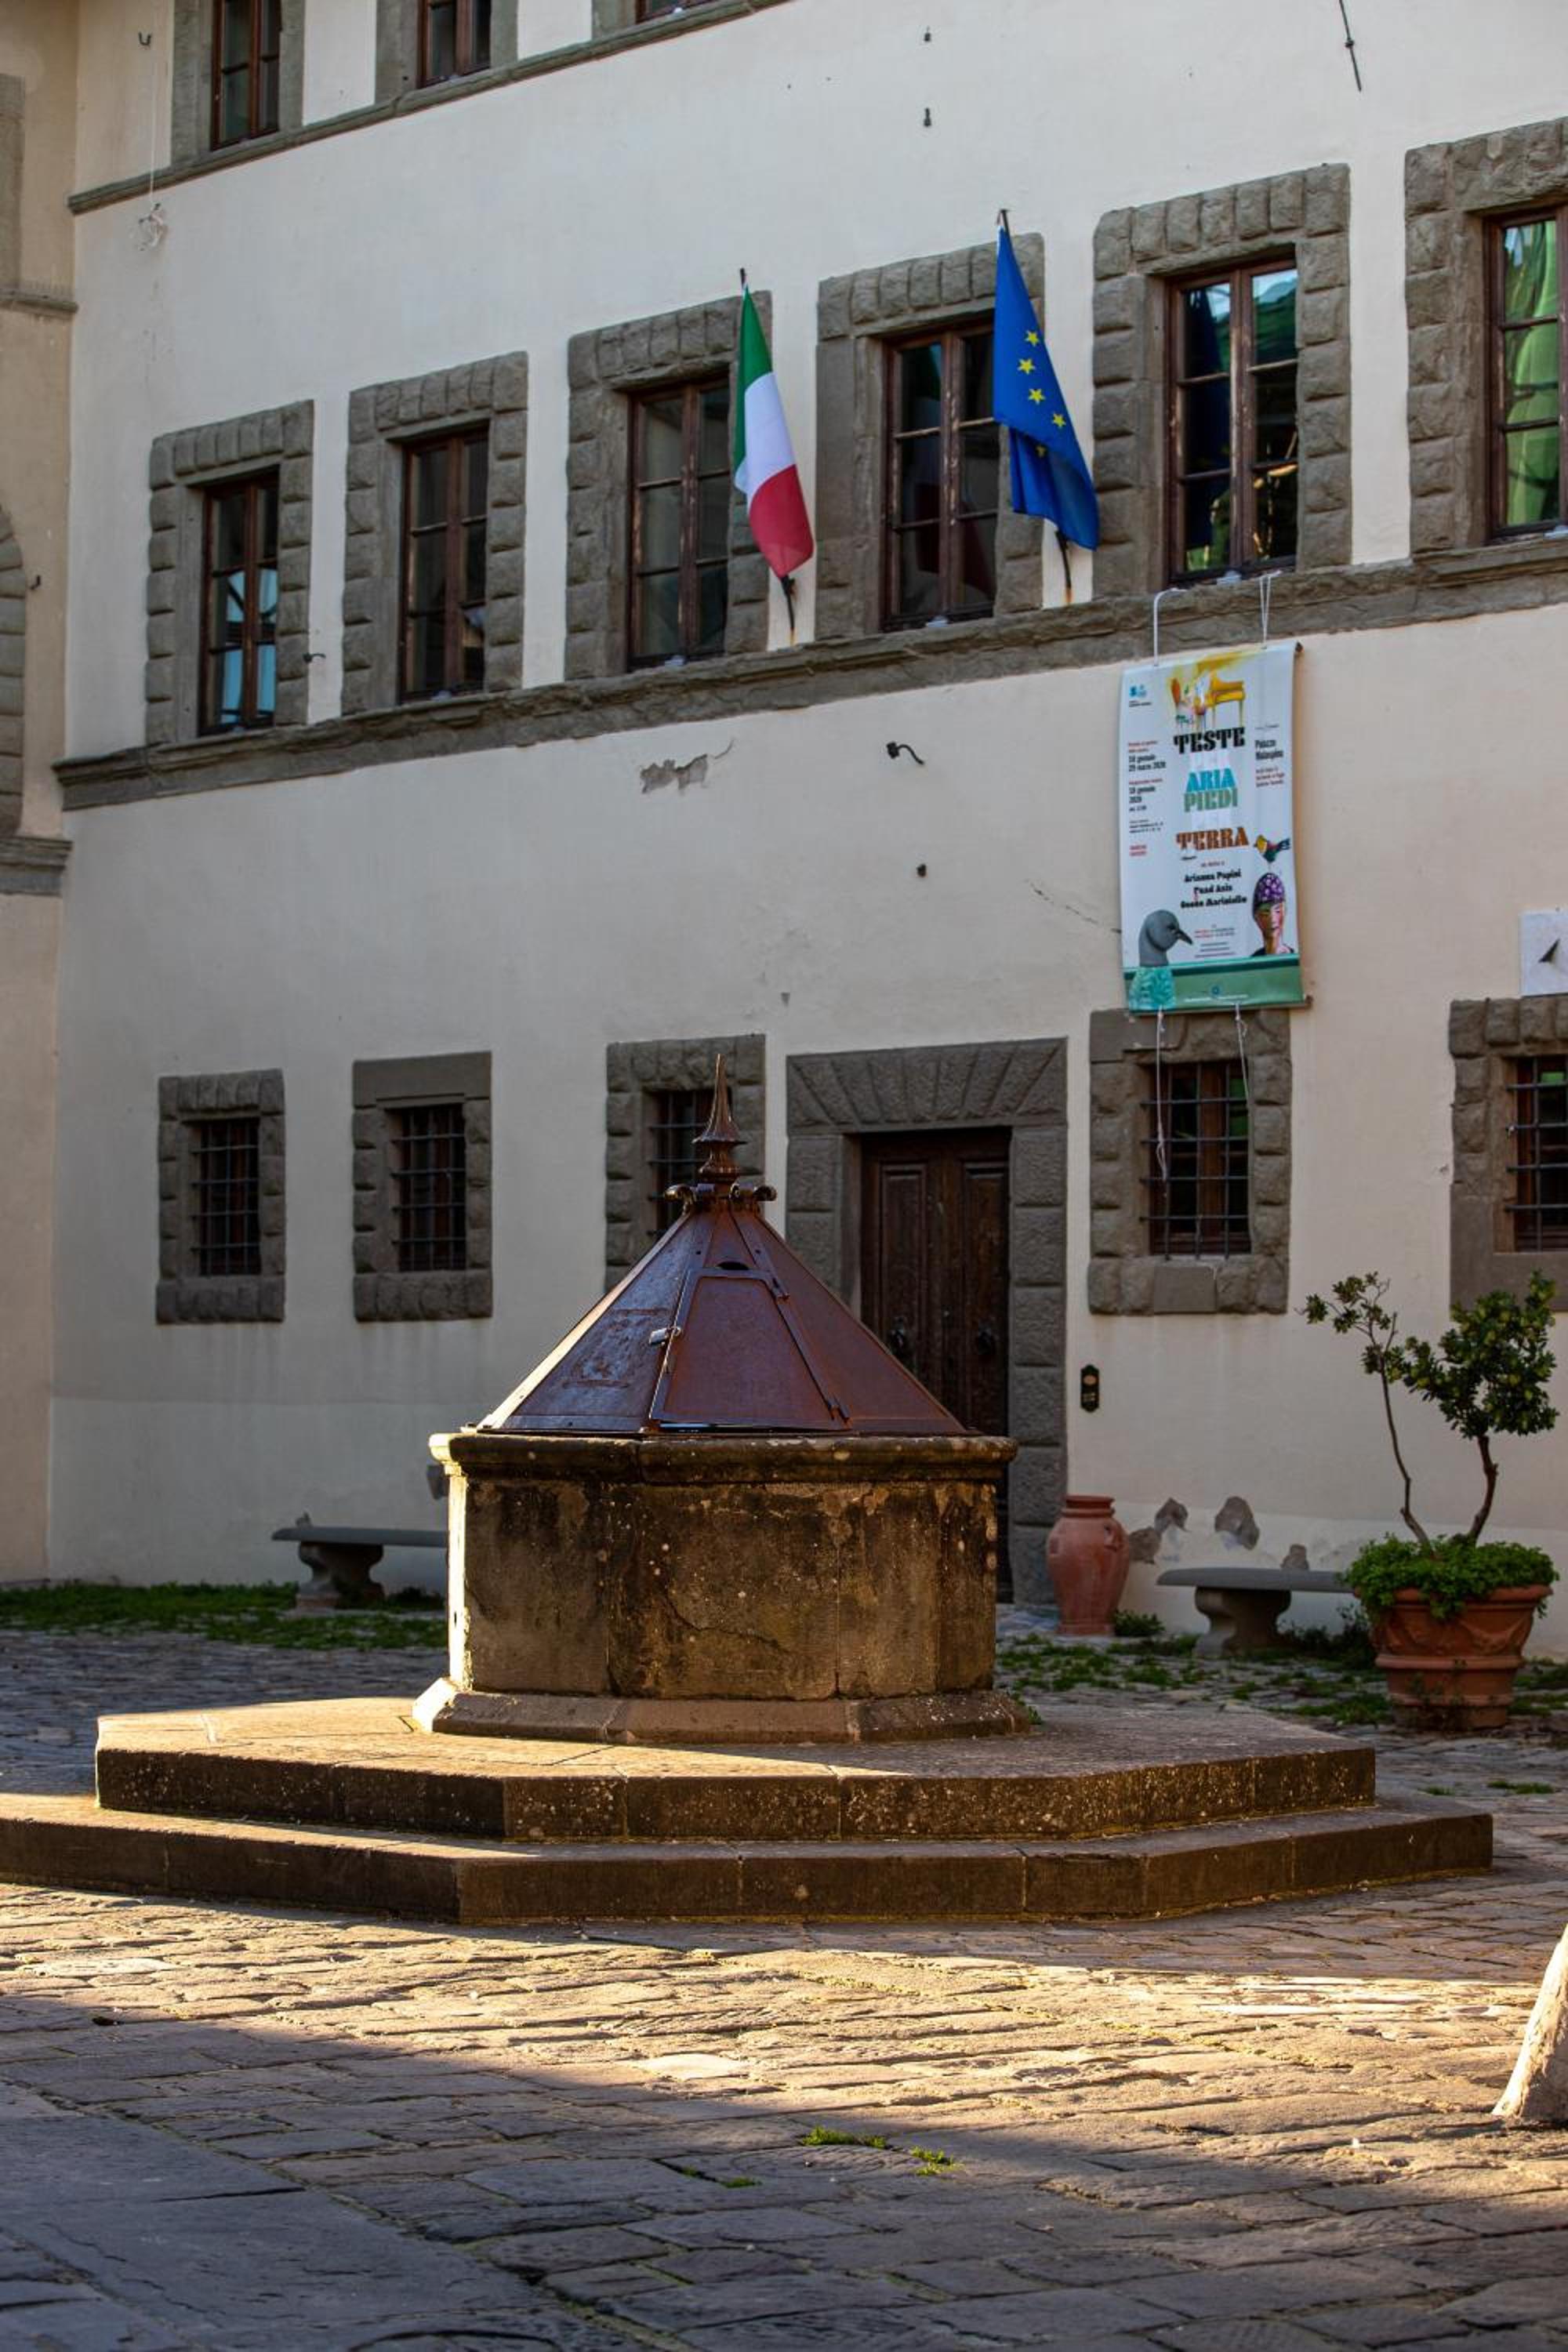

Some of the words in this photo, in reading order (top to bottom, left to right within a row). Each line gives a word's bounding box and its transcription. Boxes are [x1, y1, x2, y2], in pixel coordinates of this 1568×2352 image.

[1174, 727, 1245, 754] TESTE
[1185, 768, 1236, 793] ARIA
[1184, 787, 1238, 812] PIEDI
[1176, 826, 1249, 851] TERRA
